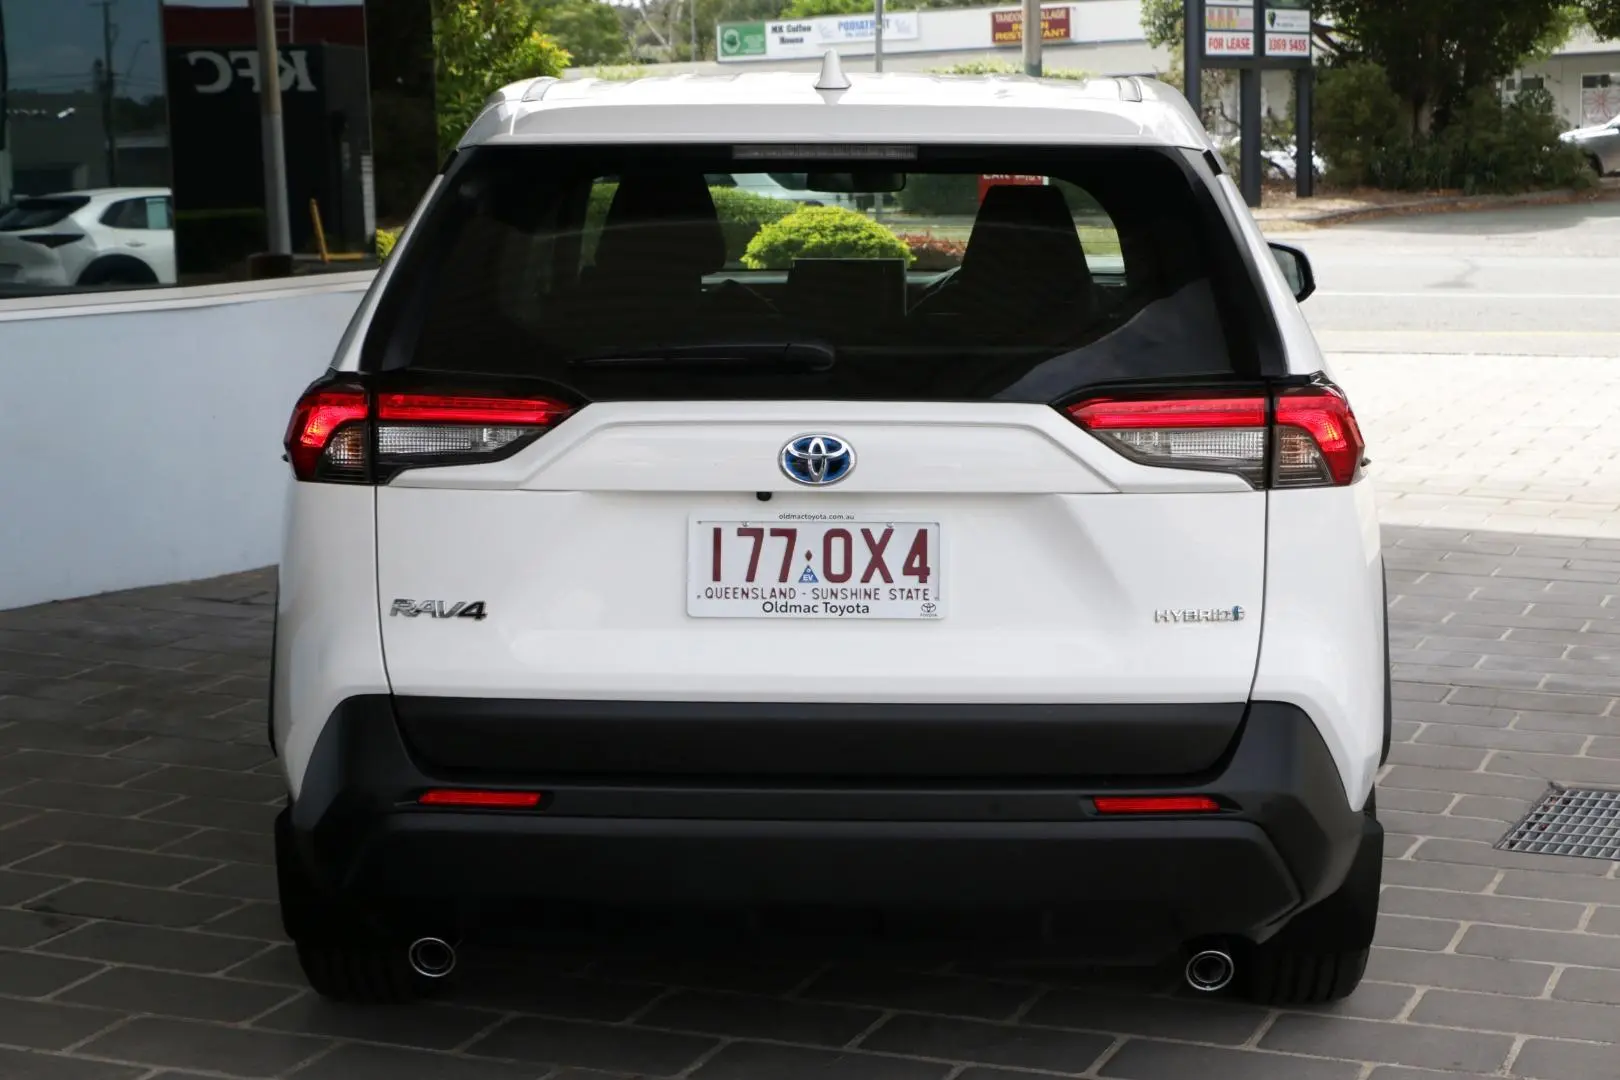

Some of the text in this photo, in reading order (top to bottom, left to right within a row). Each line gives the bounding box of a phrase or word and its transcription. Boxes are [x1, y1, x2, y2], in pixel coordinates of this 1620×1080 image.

[995, 28, 1066, 40] RESTANT
[1208, 37, 1250, 50] FOR LEASE
[802, 574, 814, 582] EV
[705, 587, 797, 600] QUEENSLAND
[812, 587, 880, 600] SUNSHINE
[889, 588, 930, 601] STATE
[389, 599, 488, 621] RAV4
[762, 602, 870, 617] Oldmac Toyota
[1154, 608, 1231, 623] HYBRID
